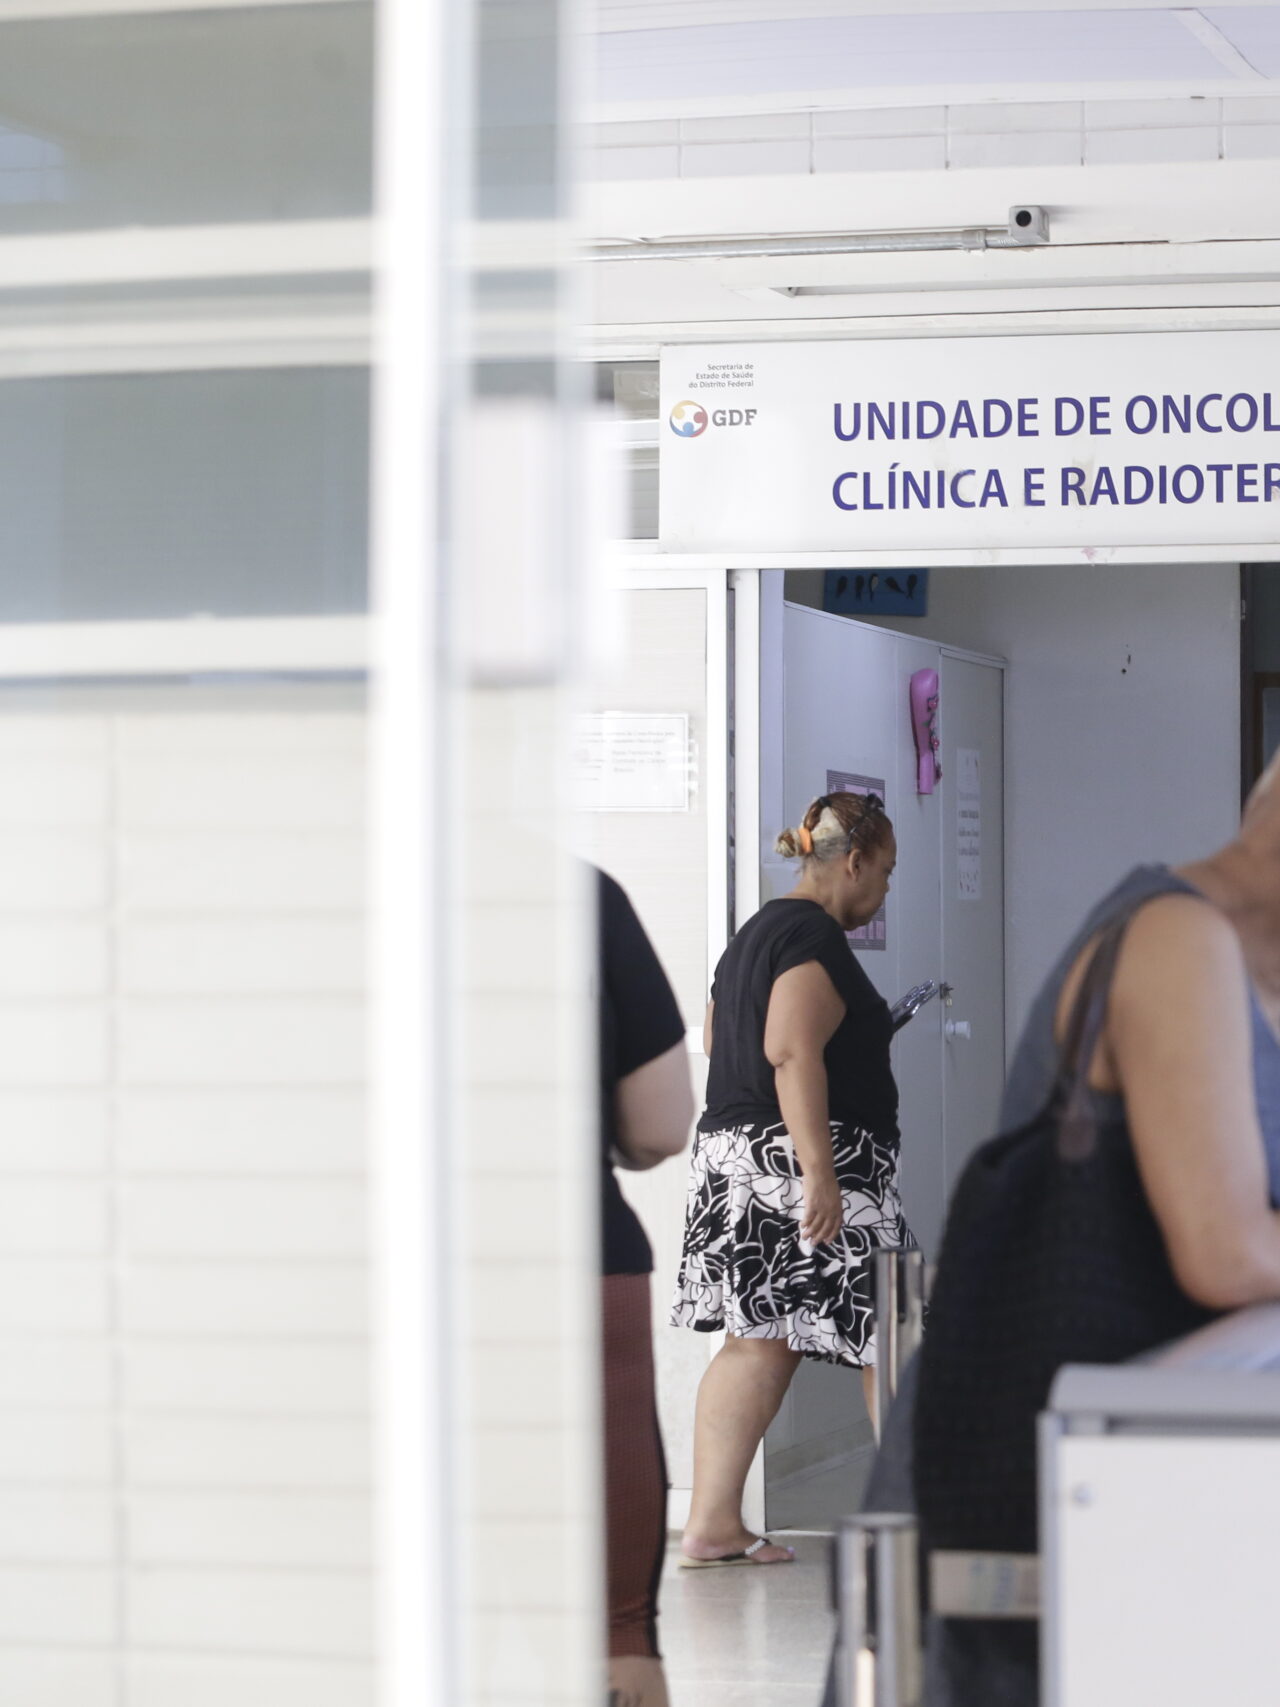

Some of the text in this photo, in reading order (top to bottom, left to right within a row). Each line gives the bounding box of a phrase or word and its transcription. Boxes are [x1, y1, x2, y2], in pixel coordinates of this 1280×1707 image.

[708, 363, 743, 371] Secretaria
[732, 371, 754, 379] Saúde
[727, 380, 754, 388] Federal
[712, 409, 758, 427] GDF
[832, 398, 1039, 441] UNIDADE
[1055, 396, 1112, 437] DE
[832, 463, 1009, 511] CLÍNICA
[1024, 468, 1046, 507] E
